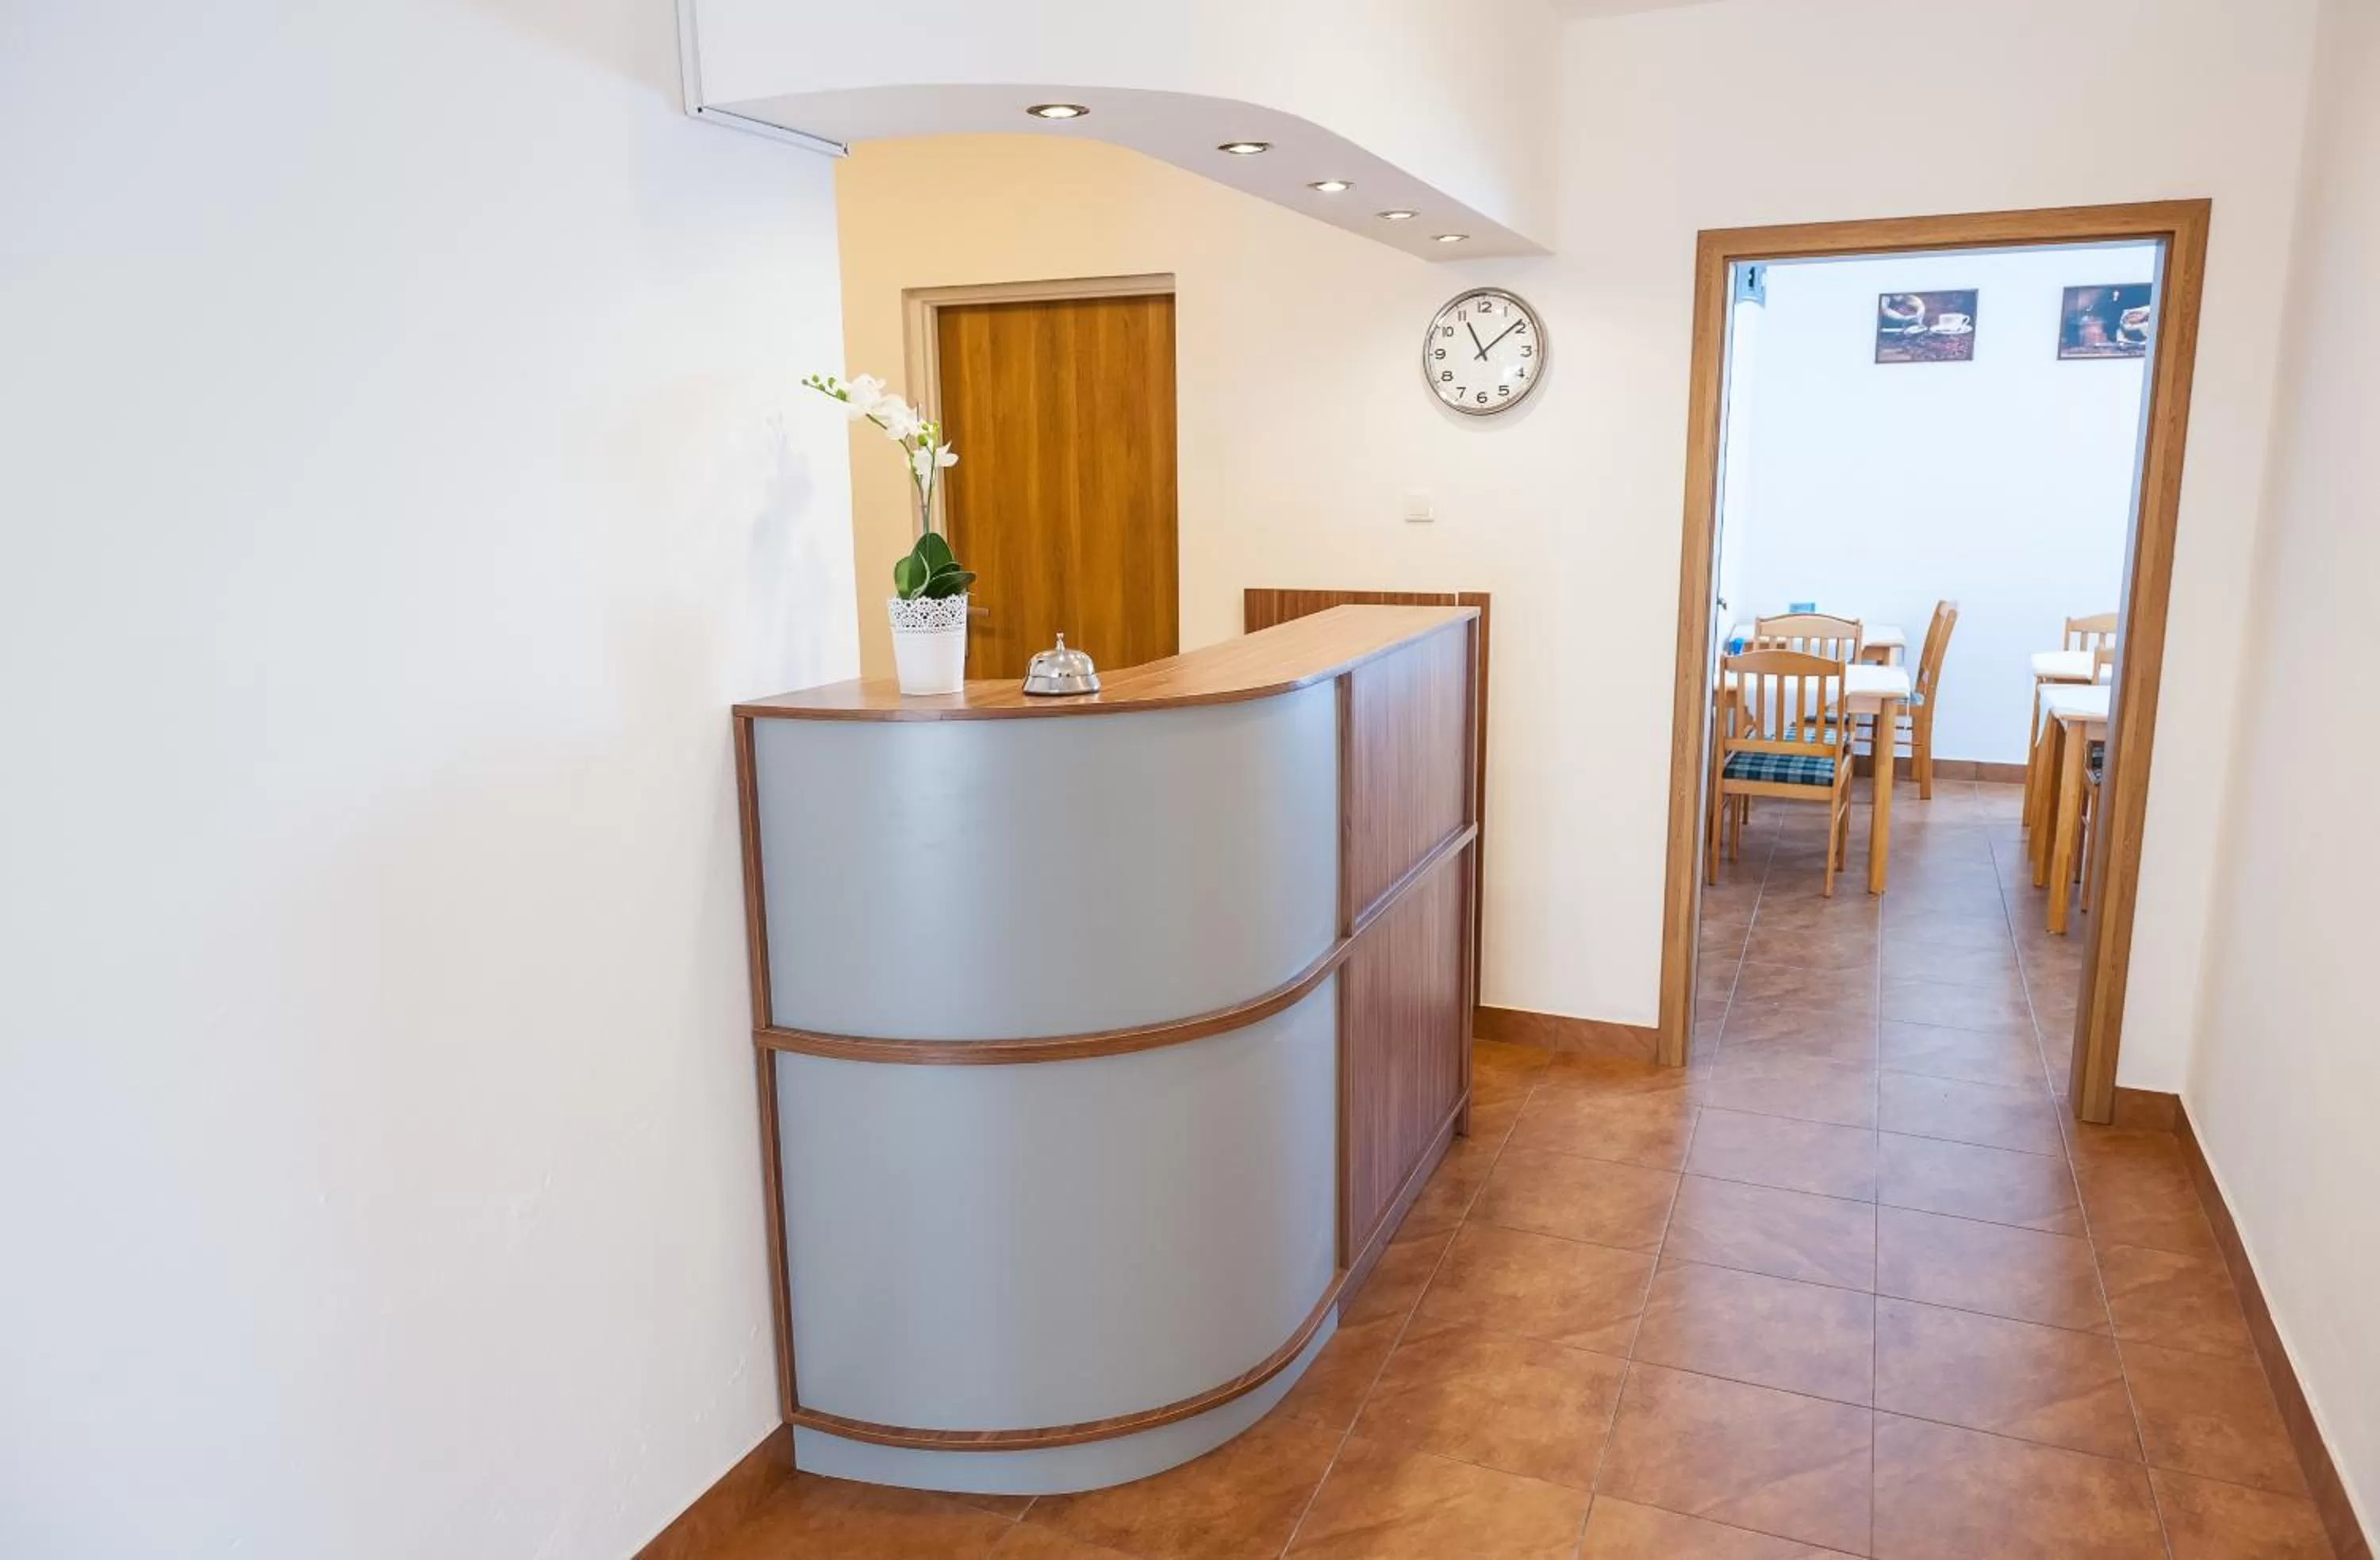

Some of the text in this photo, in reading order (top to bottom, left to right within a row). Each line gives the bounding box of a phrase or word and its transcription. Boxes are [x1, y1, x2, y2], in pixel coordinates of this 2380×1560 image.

[1477, 301, 1492, 313] 12
[1457, 310, 1467, 321] 11
[1441, 326, 1454, 337] 10
[1514, 321, 1526, 334] 2
[1434, 348, 1446, 359] 9
[1521, 345, 1532, 357] 3
[1441, 371, 1453, 382] 8
[1516, 367, 1525, 378] 4
[1456, 386, 1466, 398] 7
[1498, 385, 1510, 396] 5
[1476, 391, 1488, 403] 6
